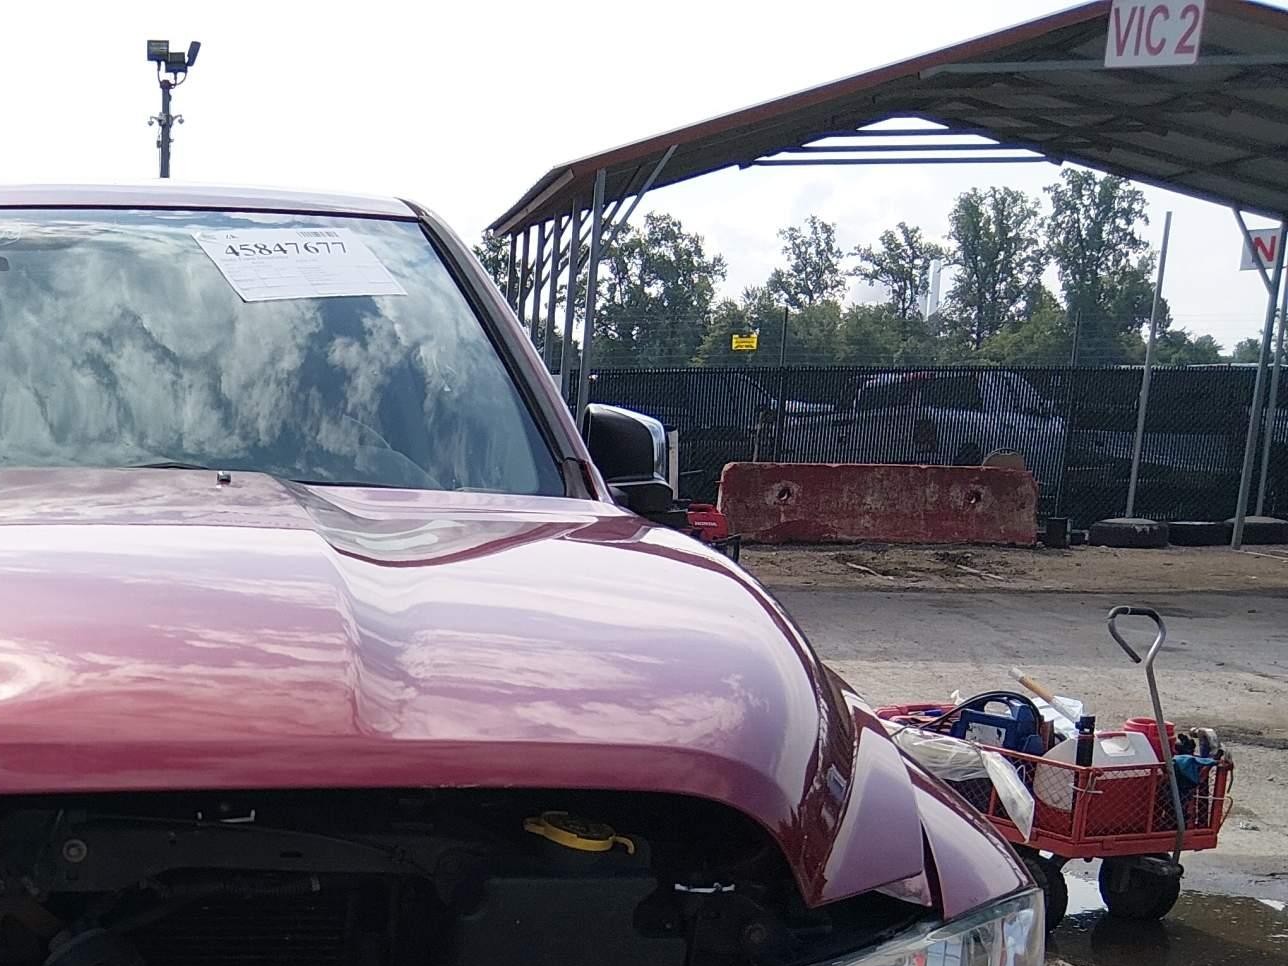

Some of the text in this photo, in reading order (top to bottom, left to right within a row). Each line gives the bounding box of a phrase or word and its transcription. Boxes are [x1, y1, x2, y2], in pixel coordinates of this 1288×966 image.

[1114, 3, 1200, 56] VIC 2
[225, 241, 347, 257] 45847677
